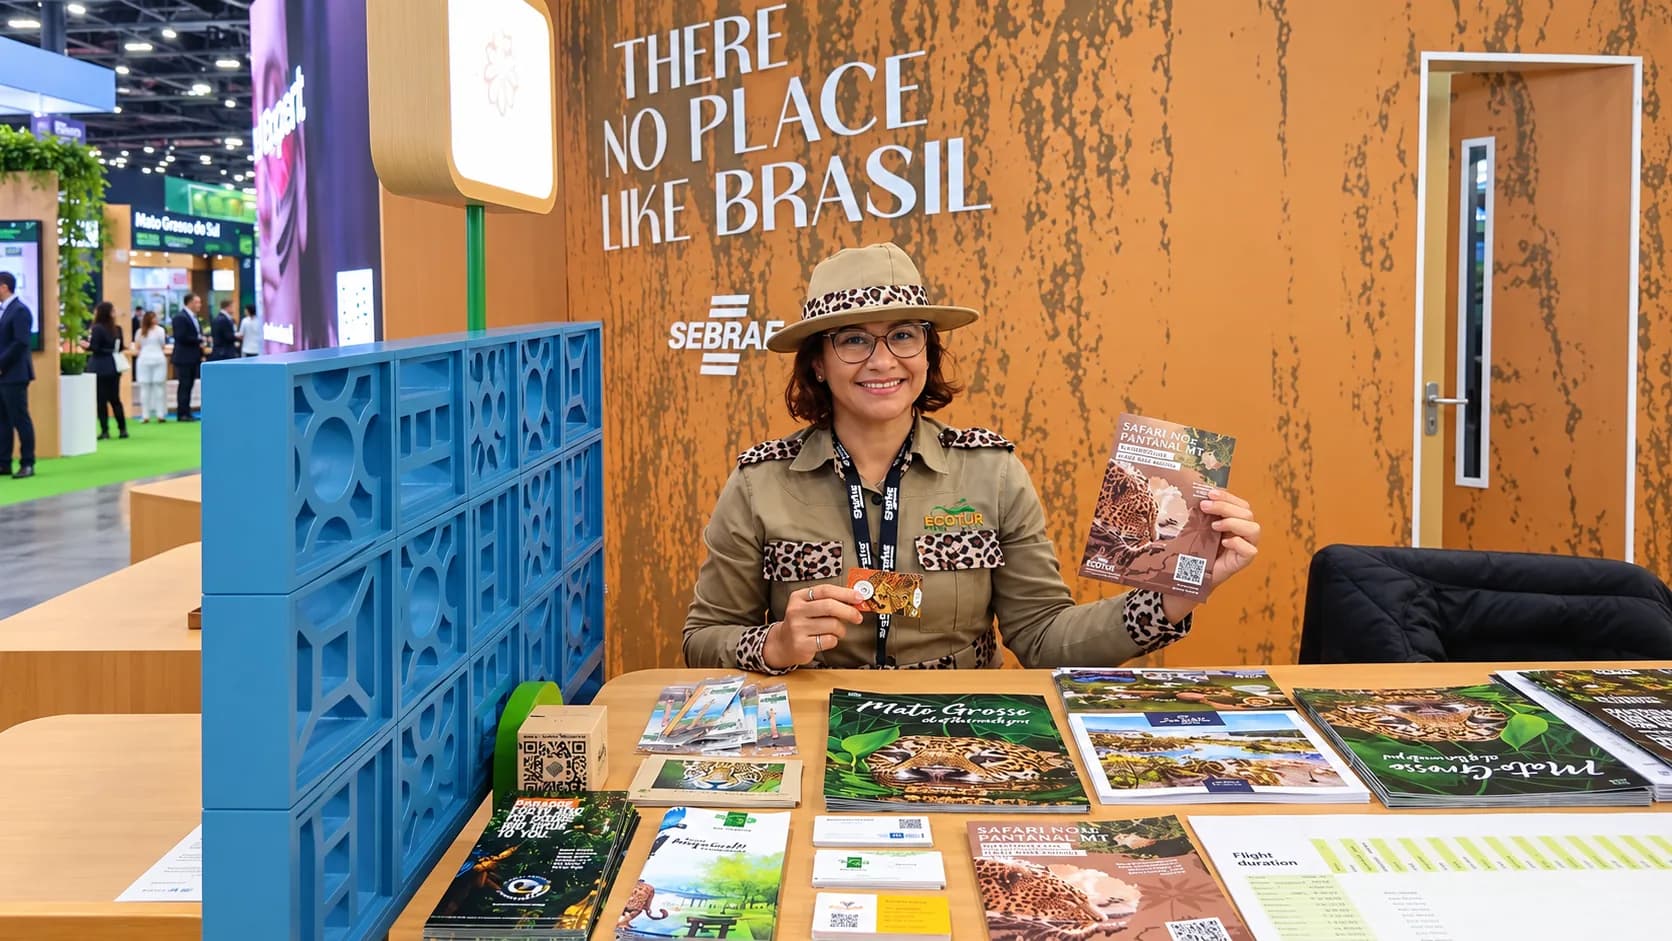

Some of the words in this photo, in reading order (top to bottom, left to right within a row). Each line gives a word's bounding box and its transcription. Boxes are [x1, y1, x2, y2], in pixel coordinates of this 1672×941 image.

[613, 3, 789, 100] THERE
[603, 107, 668, 178] NO
[689, 50, 928, 162] PLACE
[601, 178, 691, 251] LIKE
[715, 137, 992, 236] BRASIL
[135, 211, 162, 230] Mato
[206, 221, 220, 238] Sul
[1122, 421, 1167, 439] SAFARI
[1120, 432, 1183, 452] PANTANAL
[1185, 444, 1206, 457] MT
[923, 511, 984, 527] ECOTUR
[856, 699, 936, 717] Mato
[1500, 759, 1605, 779] Mato
[977, 826, 1045, 834] SAFARI
[978, 834, 1077, 842] PANTANAL
[1080, 834, 1109, 842] MT
[1232, 851, 1274, 860] Flight
[1237, 859, 1299, 867] duration
